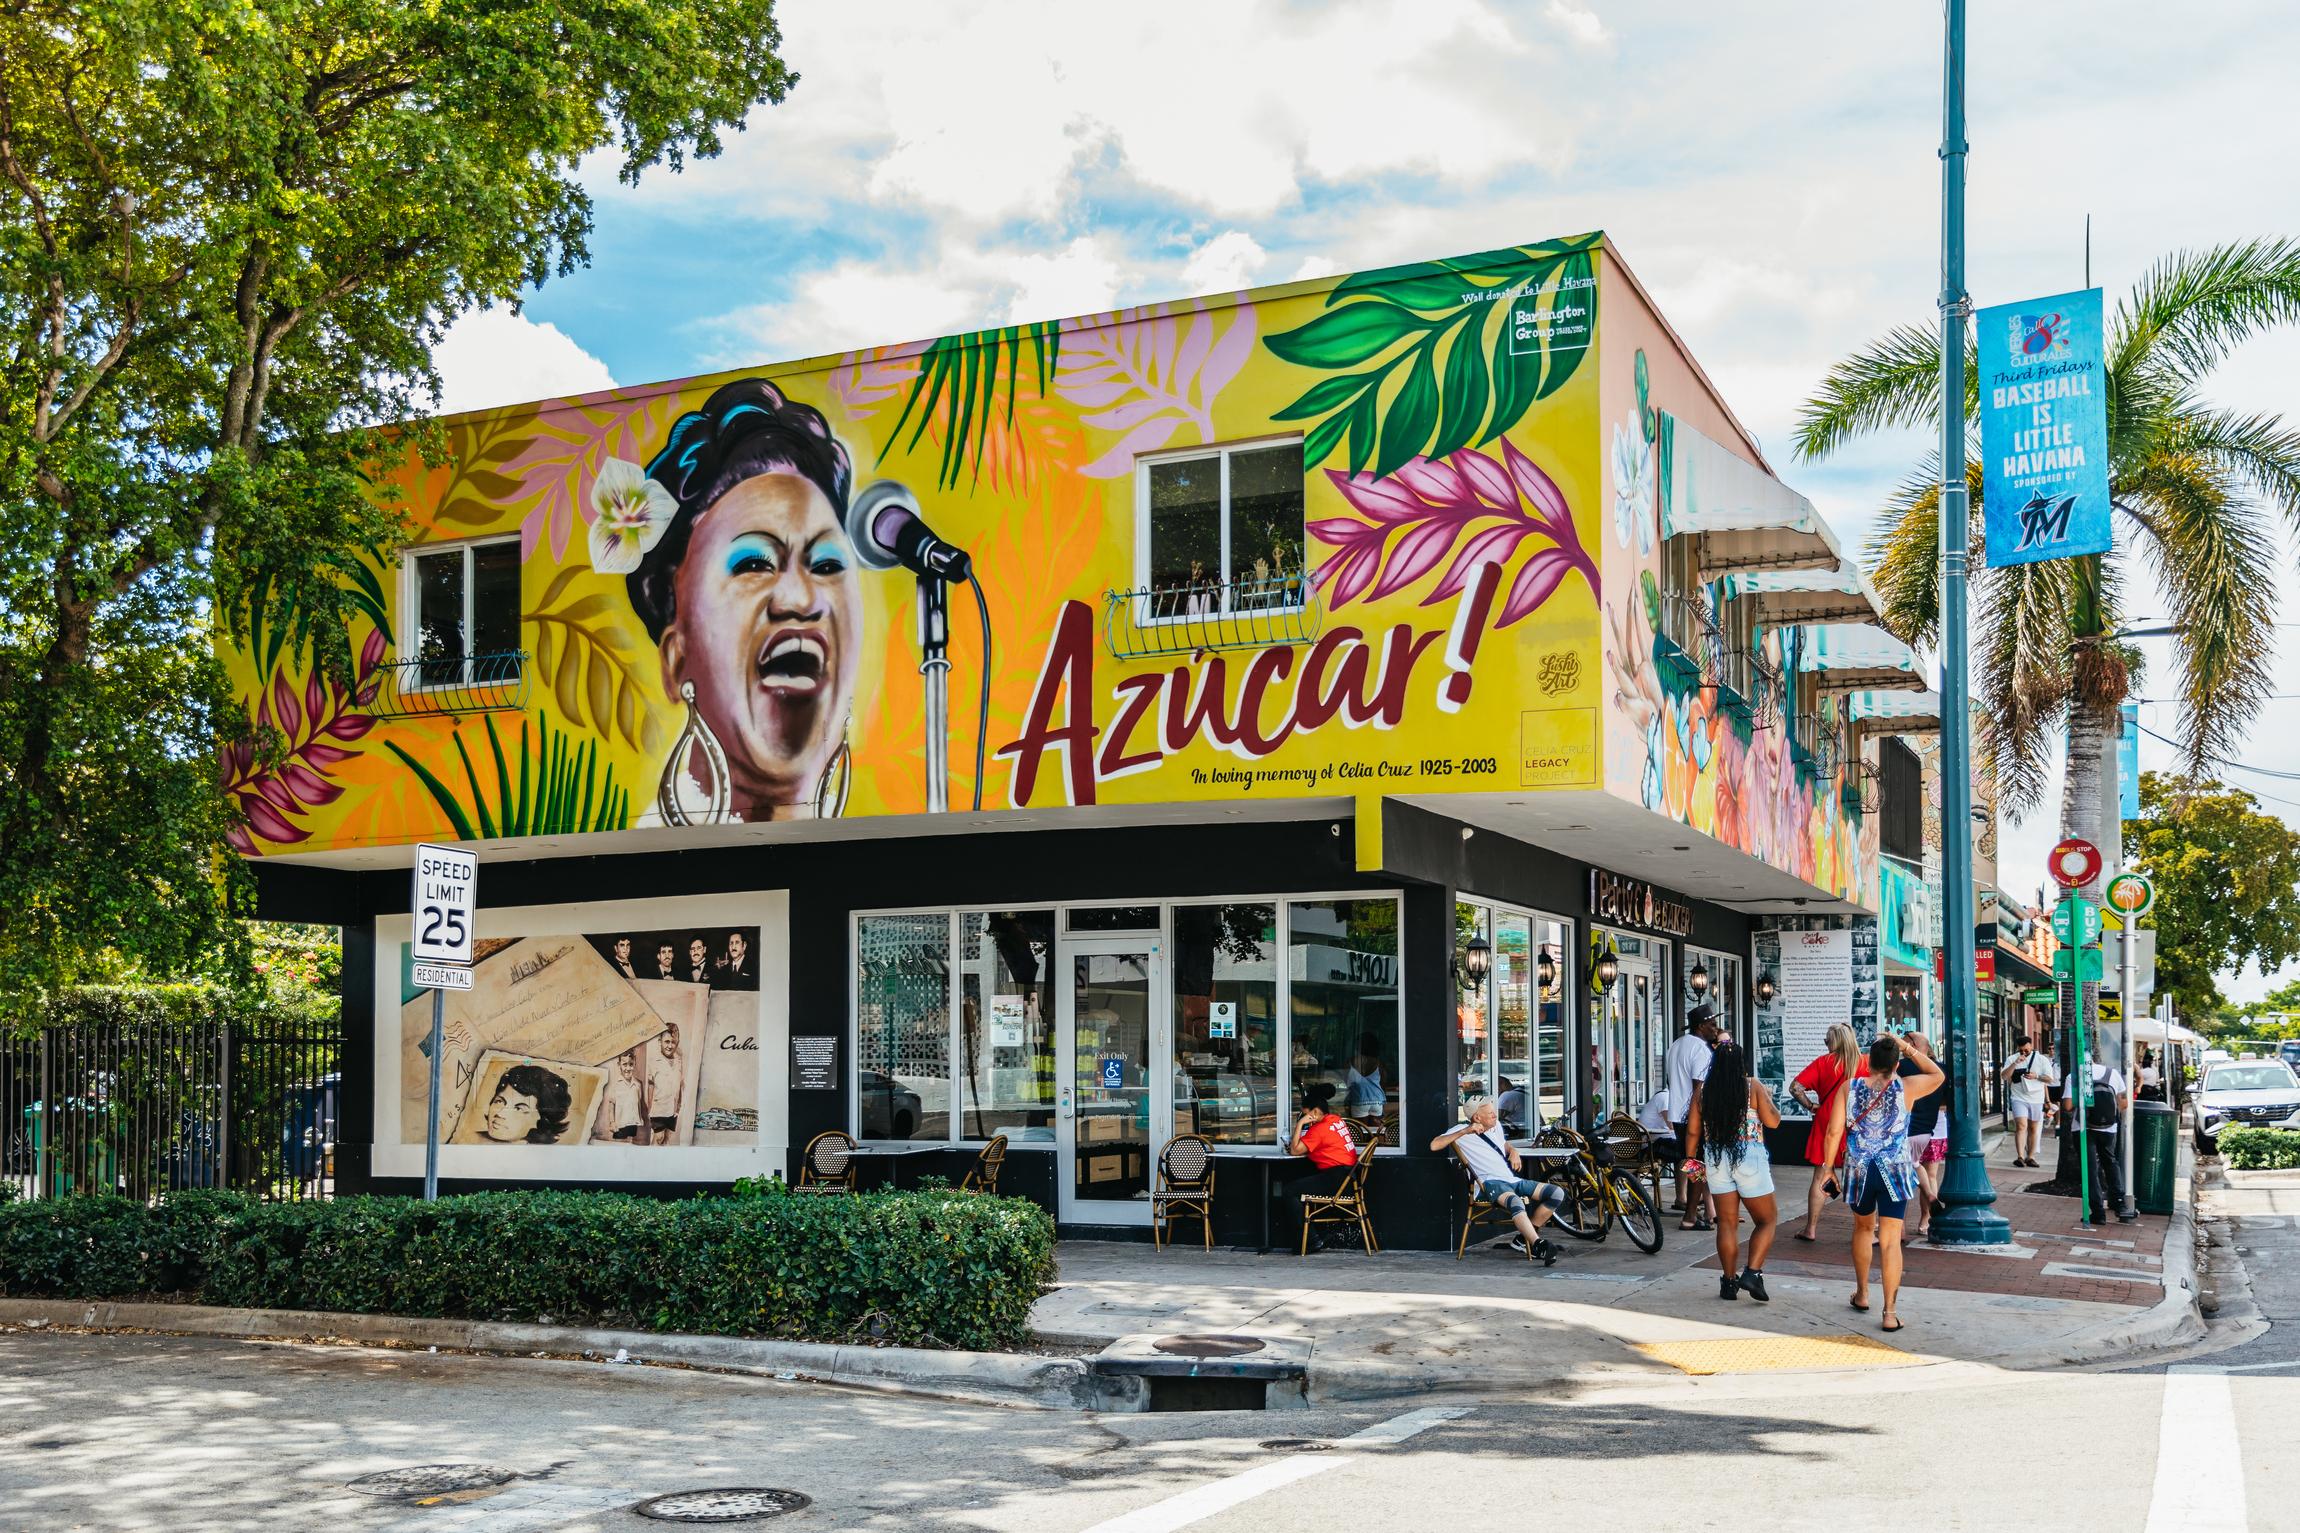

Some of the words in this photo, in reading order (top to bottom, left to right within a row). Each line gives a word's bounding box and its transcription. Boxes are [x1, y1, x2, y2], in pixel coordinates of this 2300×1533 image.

[1461, 292, 1483, 304] Wall
[1486, 287, 1521, 301] donated
[1525, 285, 1534, 295] to
[1563, 277, 1597, 289] Havana
[1515, 305, 1586, 325] Barlington
[1515, 326, 1555, 342] Group
[2010, 349, 2073, 368] CULTURALES
[1992, 367, 2036, 386] Third
[2037, 361, 2095, 380] Fridays
[1993, 374, 2091, 410] BASEBALL
[2032, 403, 2051, 427] IS
[2013, 423, 2073, 453] LITTLE
[2003, 446, 2086, 478] HAVANA
[2013, 473, 2062, 489] SPONSORED
[2065, 471, 2077, 483] BY
[994, 561, 1502, 808] Azúcar!
[1542, 672, 1577, 695] Art
[1525, 746, 1557, 757] CELIA
[1560, 744, 1592, 756] CRUZ
[1191, 768, 1208, 784] In
[1211, 768, 1253, 791] loving
[1255, 769, 1317, 788] memory
[1320, 765, 1334, 779] of
[1338, 762, 1374, 779] Celia
[1377, 761, 1414, 777] Cruz
[1420, 758, 1497, 776] 1925-2003
[1525, 758, 1569, 769] LEGACY
[1525, 769, 1575, 781] PROJECT
[422, 859, 471, 881] SPEED
[427, 882, 465, 903] LIMIT
[1600, 871, 1634, 925] Party
[1662, 900, 1696, 936] BAKERY
[421, 905, 466, 948] 25
[2084, 906, 2096, 938] BUS
[416, 968, 470, 986] RESIDENTIAL
[719, 1035, 760, 1051] Cuba
[1094, 1052, 1109, 1060] Exit
[1110, 1051, 1129, 1062] Only
